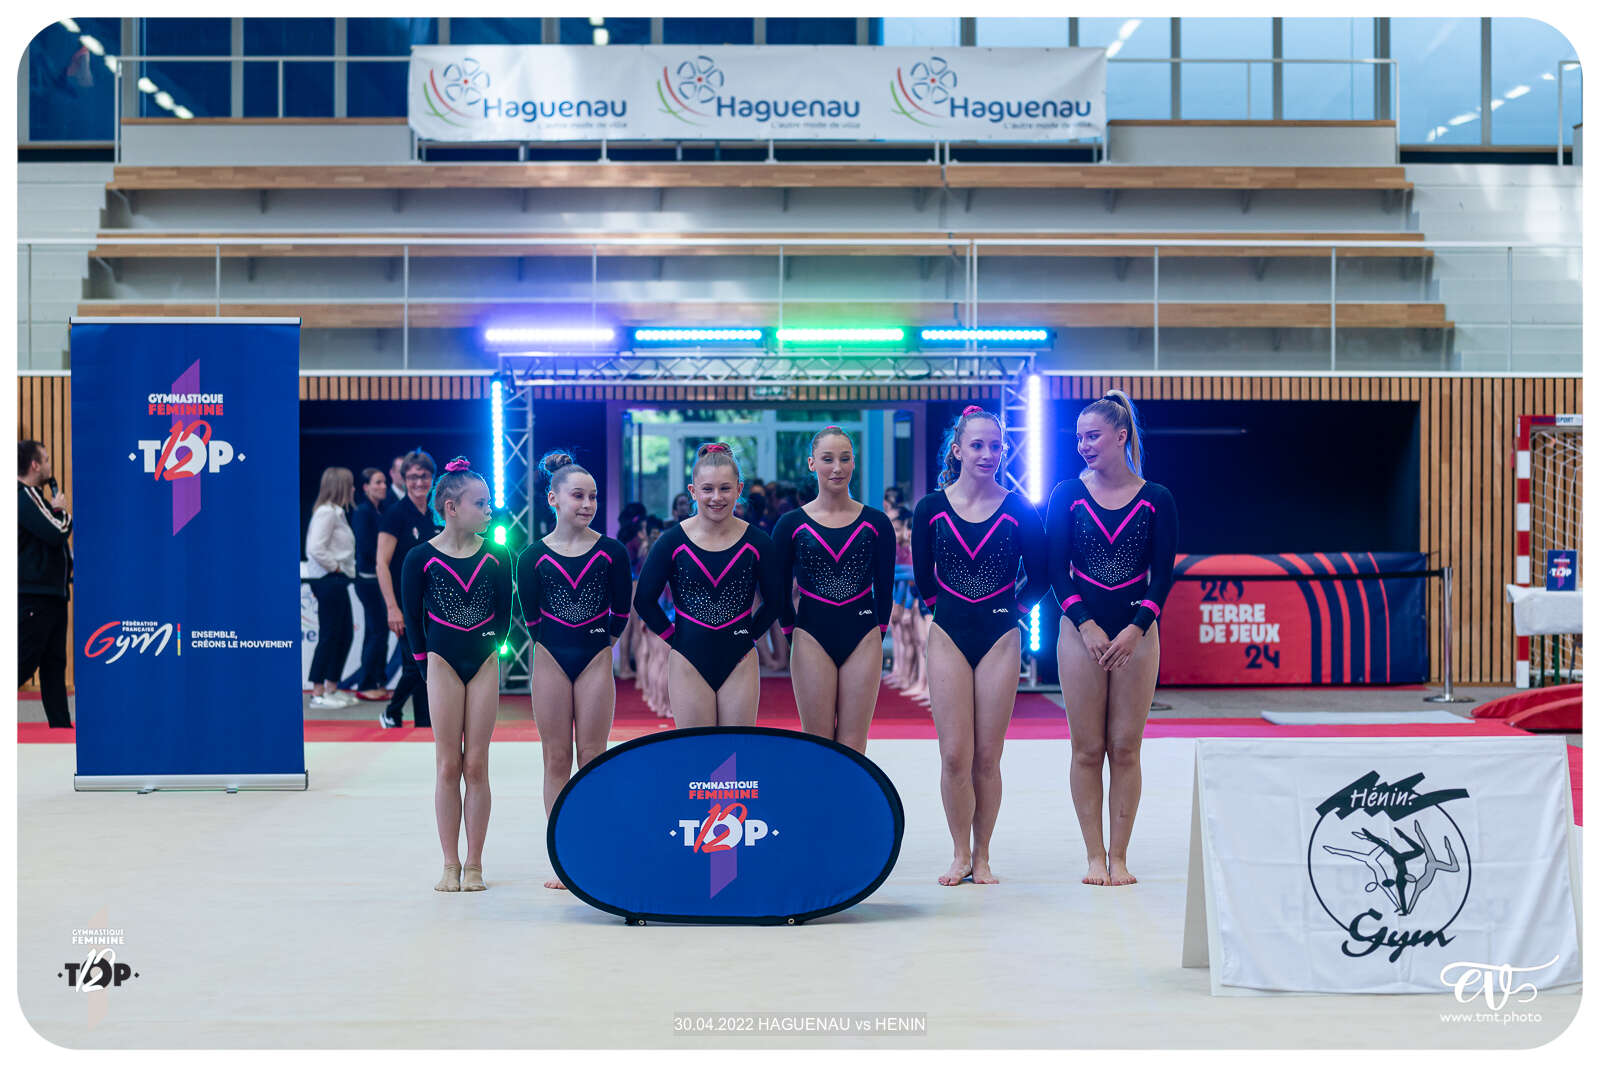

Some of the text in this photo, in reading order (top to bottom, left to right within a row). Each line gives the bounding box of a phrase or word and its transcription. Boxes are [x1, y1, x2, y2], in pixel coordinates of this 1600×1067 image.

[484, 97, 627, 122] Haguenau
[716, 96, 860, 122] Haguenau
[949, 96, 1091, 123] Haguenau
[148, 393, 224, 404] GYMNASTIQUE
[138, 431, 234, 476] TOP
[1199, 603, 1265, 623] TERRE
[191, 631, 238, 639] ENSEMBLE,
[191, 639, 293, 648] CRÉONS LE MOUVEMENT
[1199, 623, 1280, 643] DE JEUX
[1245, 644, 1280, 670] 24
[688, 781, 758, 790] GYMNASTIQUE
[679, 812, 768, 848] TOP
[1341, 908, 1456, 963] Gym
